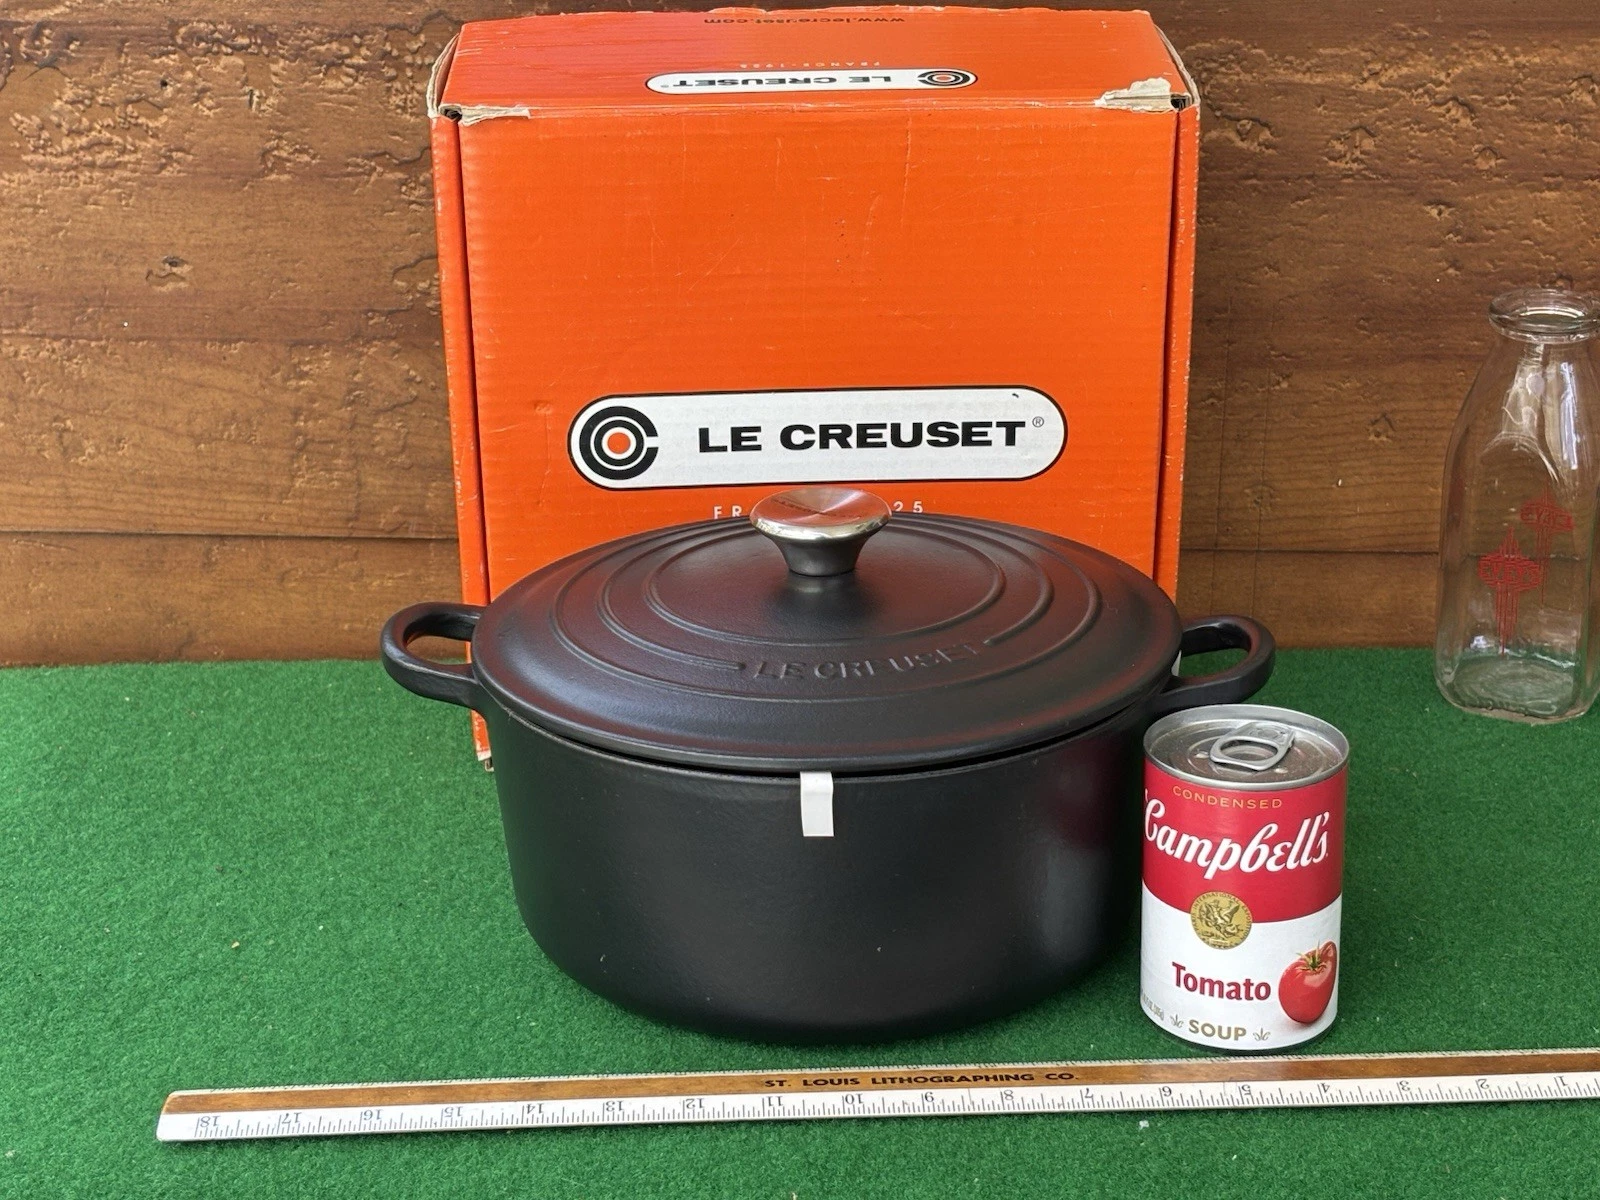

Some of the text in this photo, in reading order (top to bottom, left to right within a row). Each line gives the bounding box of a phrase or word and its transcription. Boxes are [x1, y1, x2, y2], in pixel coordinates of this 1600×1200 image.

[849, 75, 892, 83] LE
[698, 425, 762, 453] LE
[753, 660, 807, 680] LE
[1172, 785, 1282, 809] CONDENSED
[1144, 789, 1331, 880] Campbell's
[1171, 961, 1272, 1002] Tomato
[1187, 1018, 1247, 1042] SOUP
[764, 1071, 1079, 1088] ST. LOUIS LITHOGRAPHING CO.
[199, 1114, 221, 1128] 18
[281, 1111, 302, 1124] 17
[362, 1108, 383, 1121] 16
[443, 1105, 464, 1118] 15
[524, 1102, 545, 1115] 14
[605, 1099, 625, 1112] 13
[685, 1097, 705, 1110] 12
[765, 1095, 784, 1108] 11
[845, 1093, 864, 1105] 10
